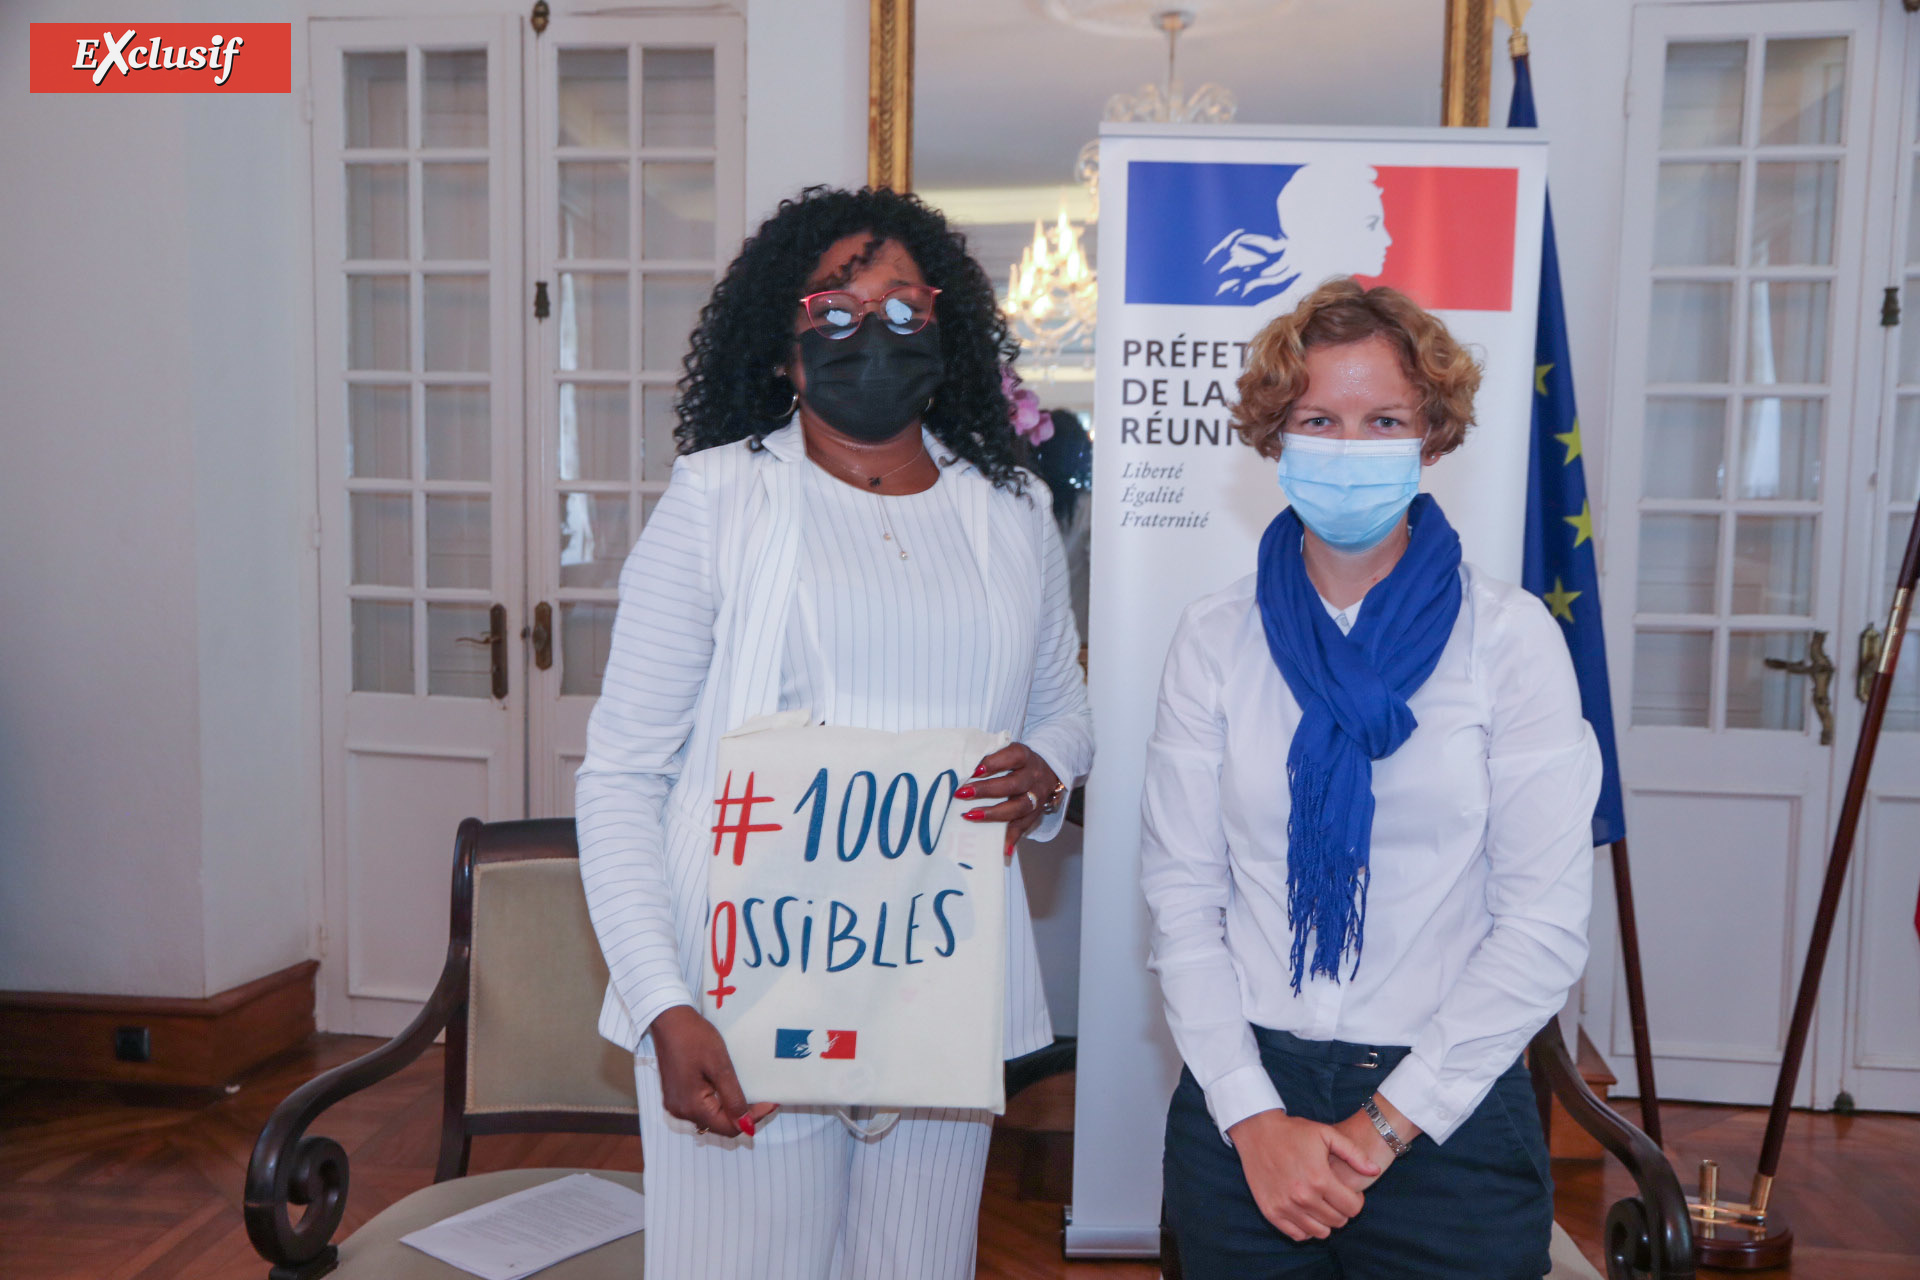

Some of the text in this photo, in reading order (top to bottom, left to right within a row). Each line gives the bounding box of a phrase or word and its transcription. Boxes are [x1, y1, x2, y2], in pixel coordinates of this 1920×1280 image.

[1122, 333, 1251, 368] PRÉFET
[1121, 378, 1229, 407] DE LA
[1120, 410, 1232, 446] RÉUNI
[1121, 462, 1185, 479] Liberté
[1120, 484, 1185, 507] Égalité
[1120, 510, 1210, 529] Fraternité
